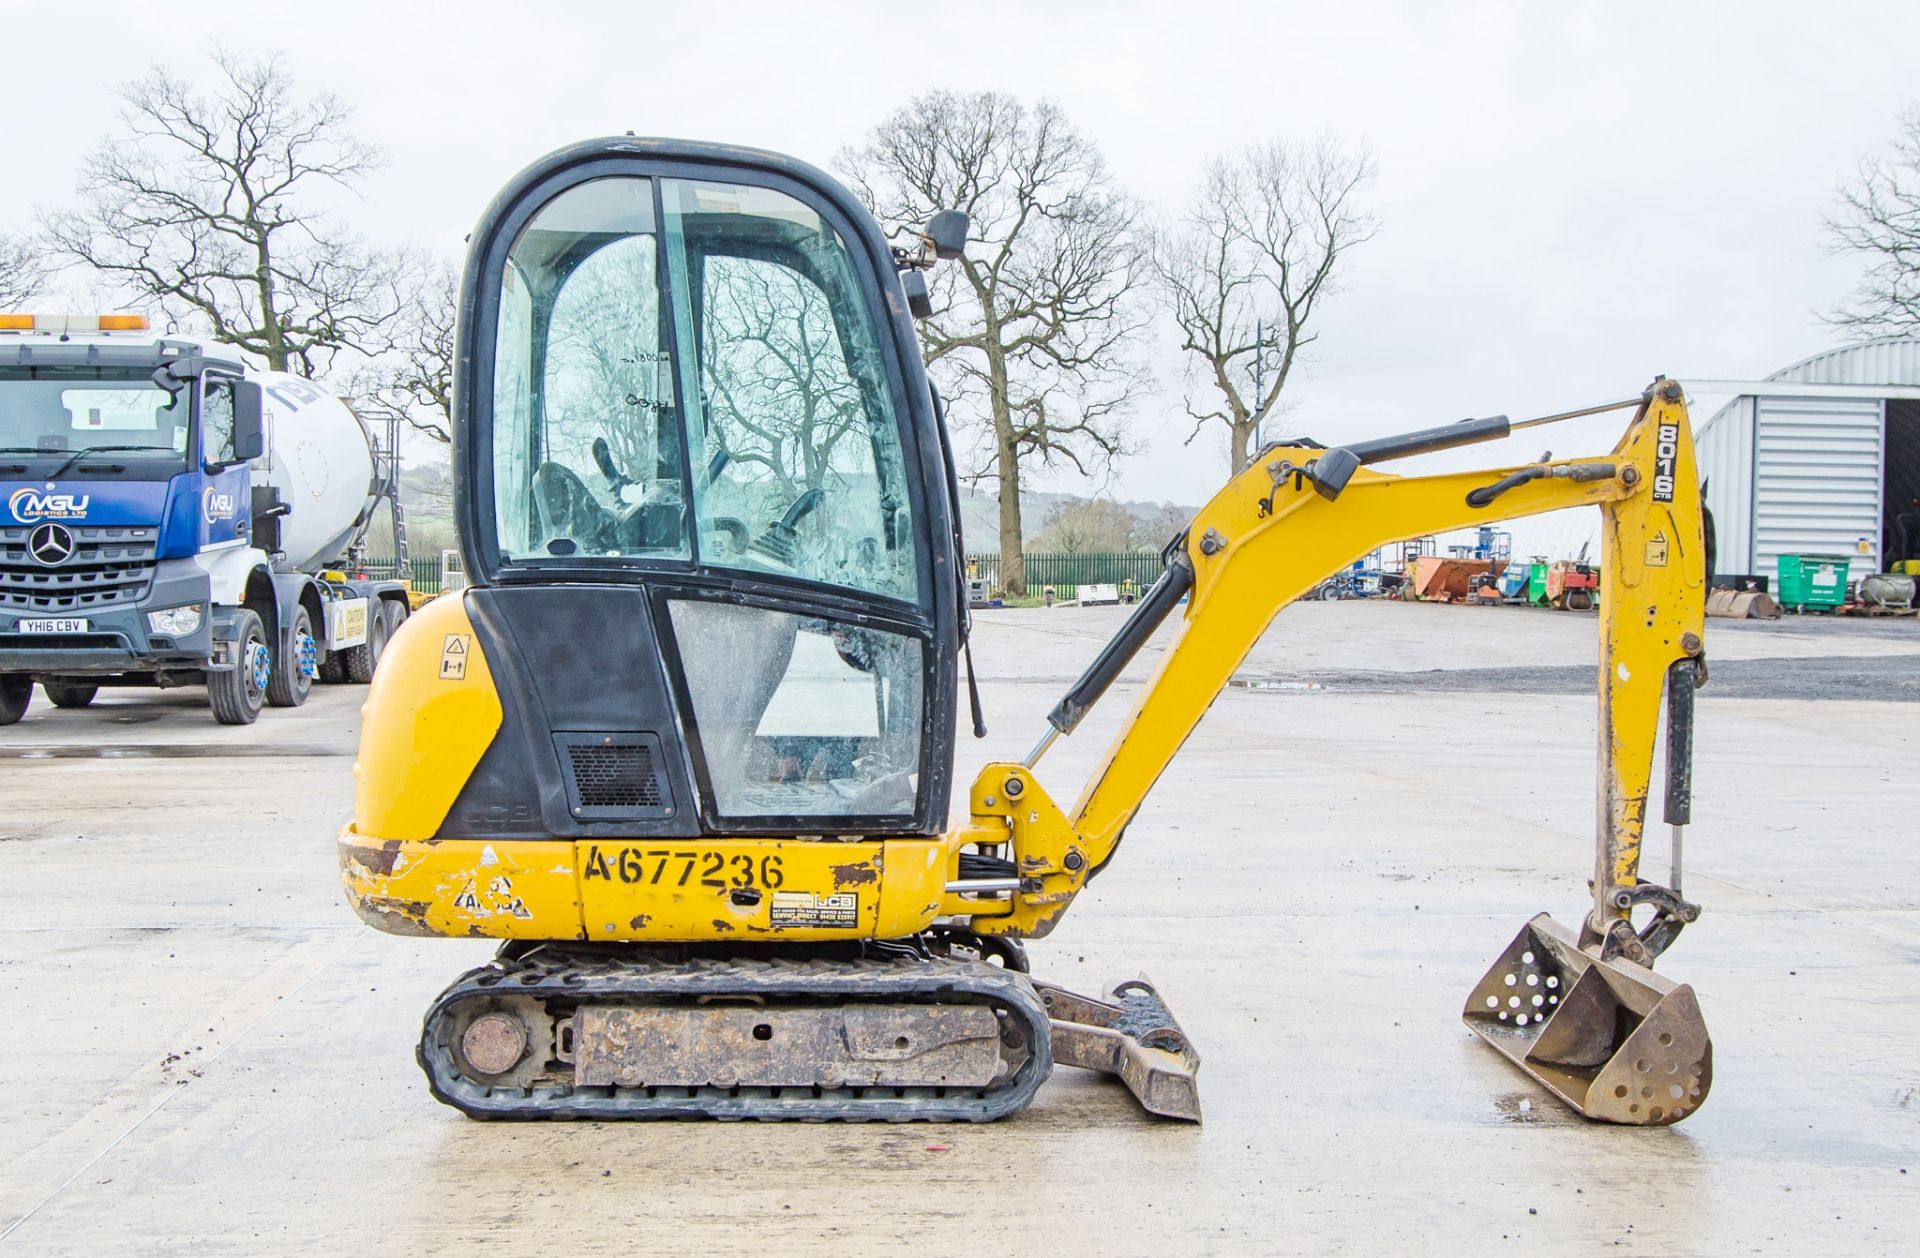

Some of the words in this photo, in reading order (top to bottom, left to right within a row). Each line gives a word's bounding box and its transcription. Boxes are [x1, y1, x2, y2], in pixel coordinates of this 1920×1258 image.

[1654, 425, 1678, 493] 8016
[24, 495, 90, 511] MGU
[209, 494, 233, 511] MGU
[27, 620, 54, 632] YH16
[56, 620, 80, 632] CBV
[584, 845, 784, 889] A677236
